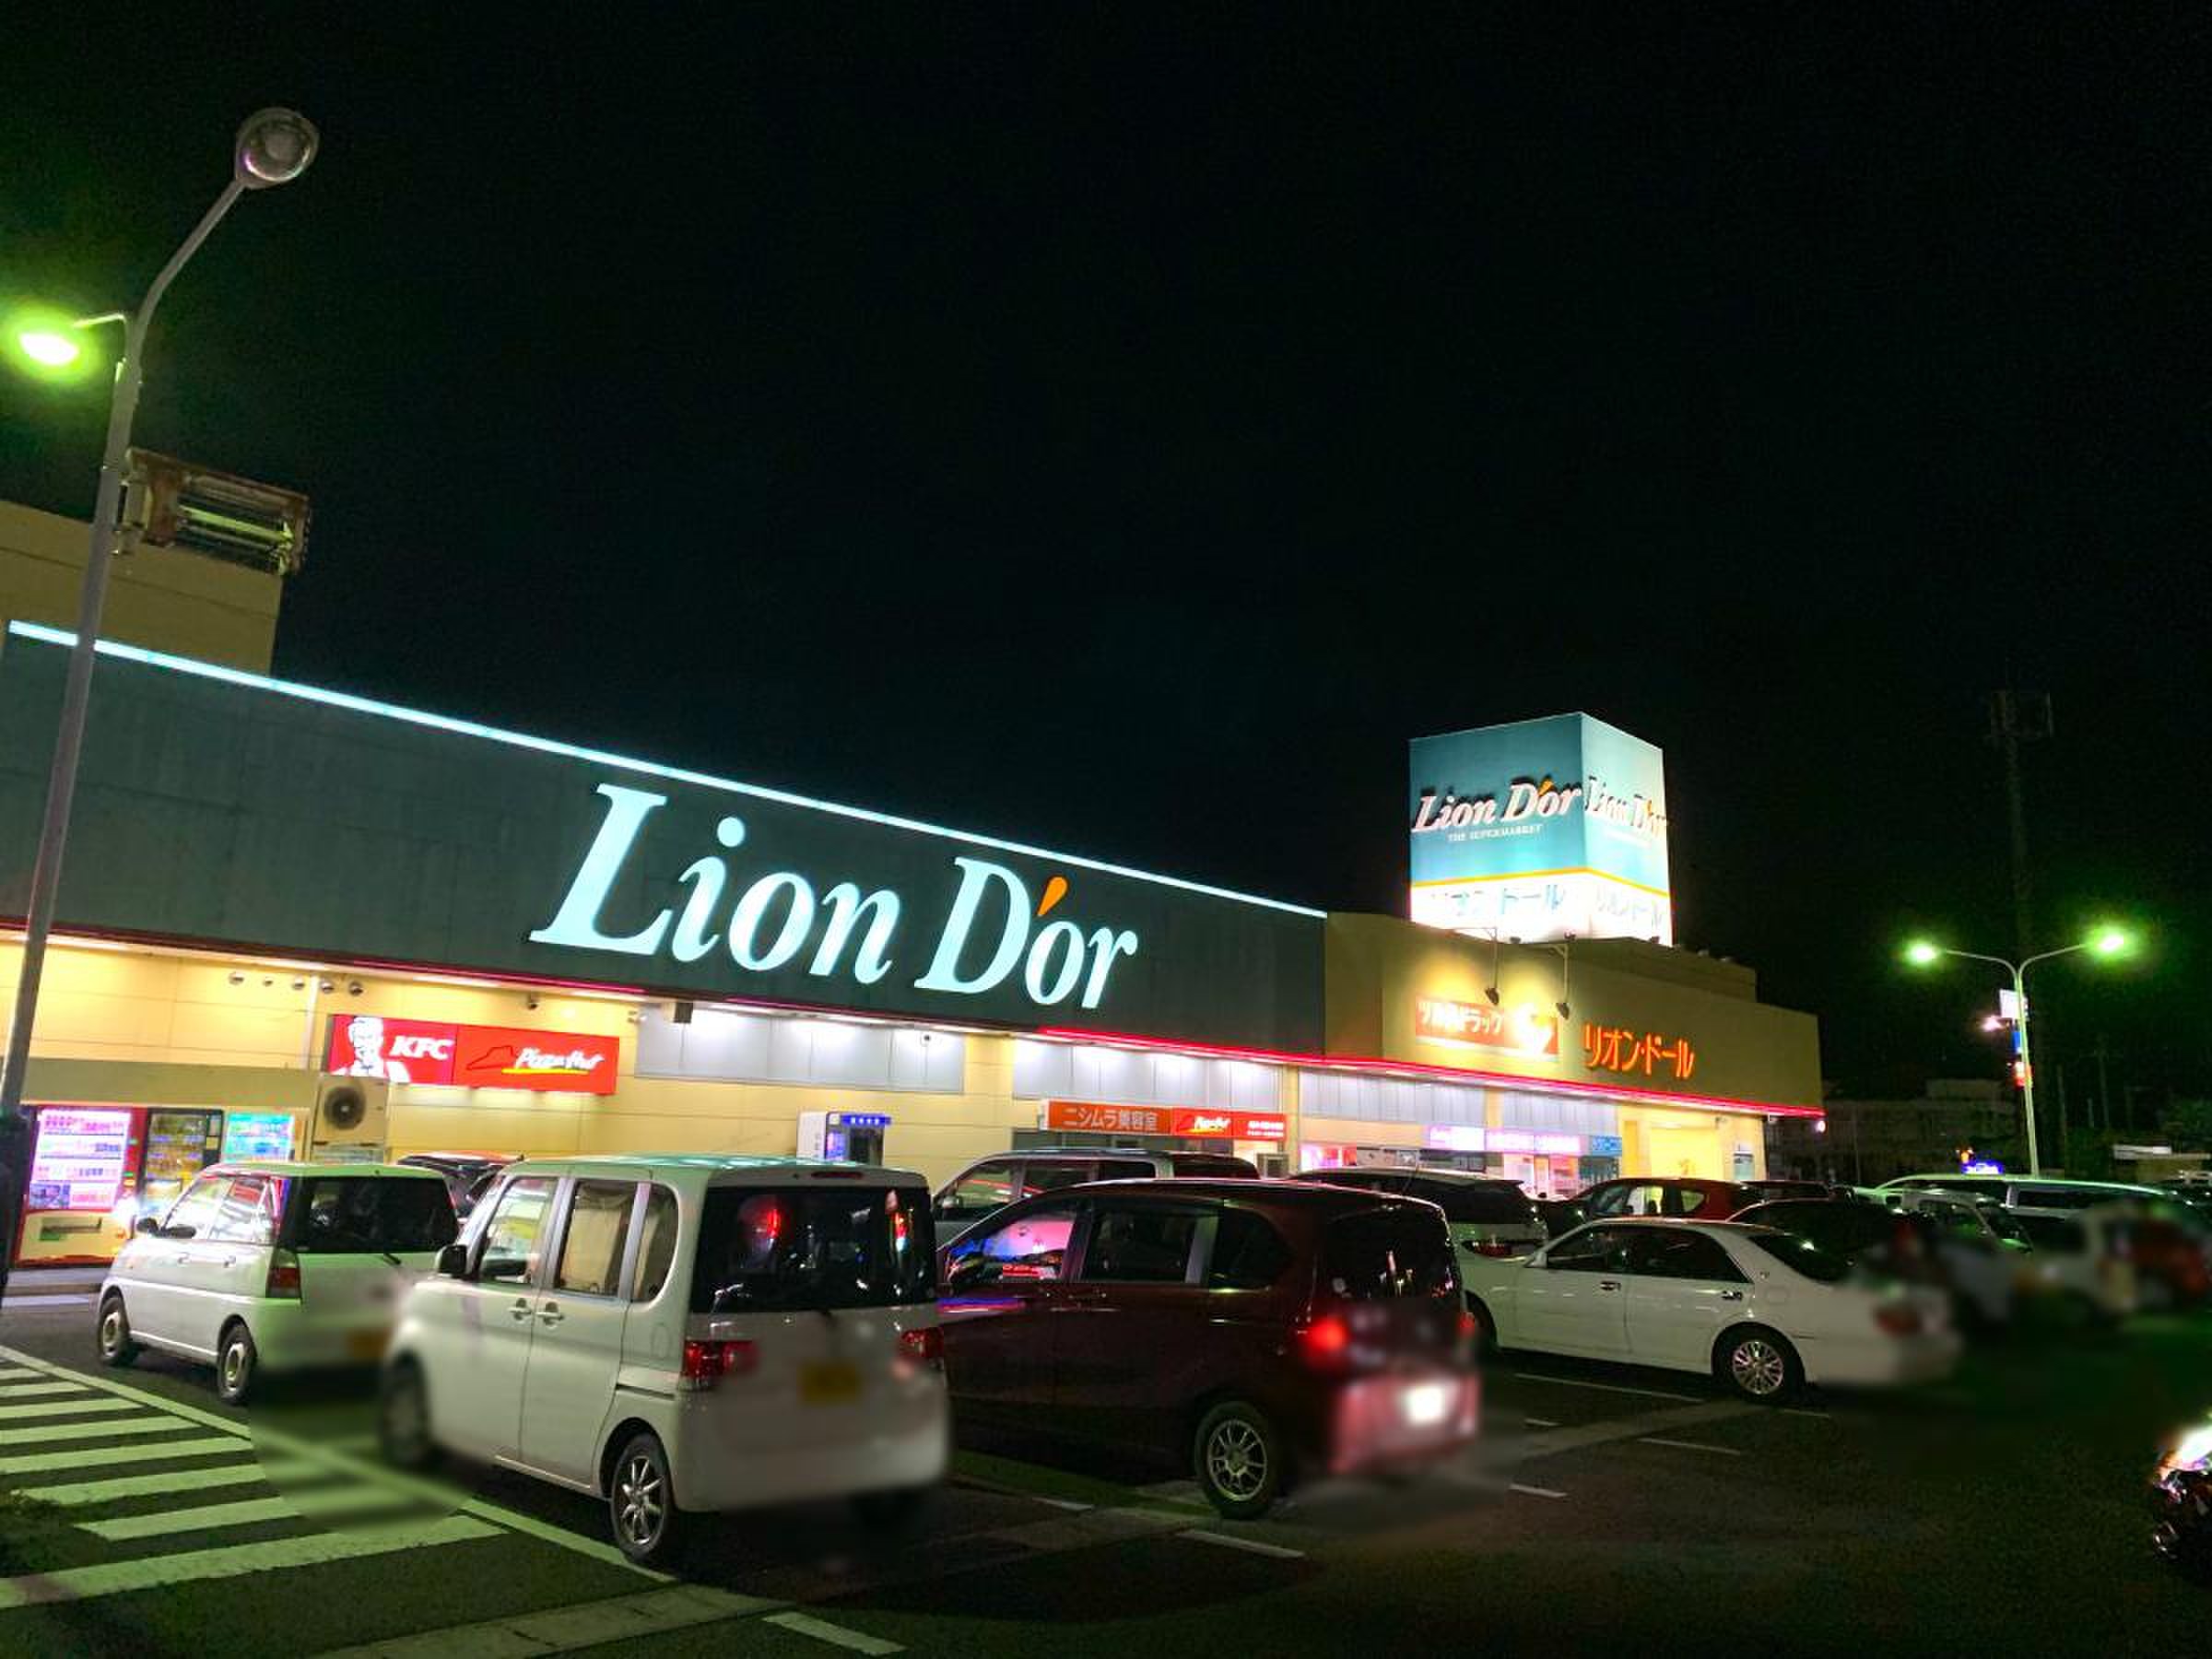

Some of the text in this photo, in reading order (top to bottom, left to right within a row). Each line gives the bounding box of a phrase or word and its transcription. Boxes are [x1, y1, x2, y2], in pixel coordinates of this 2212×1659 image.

[1411, 795, 1497, 833] Lion
[528, 782, 1138, 1009] Lion D'or
[389, 1035, 454, 1060] KFC
